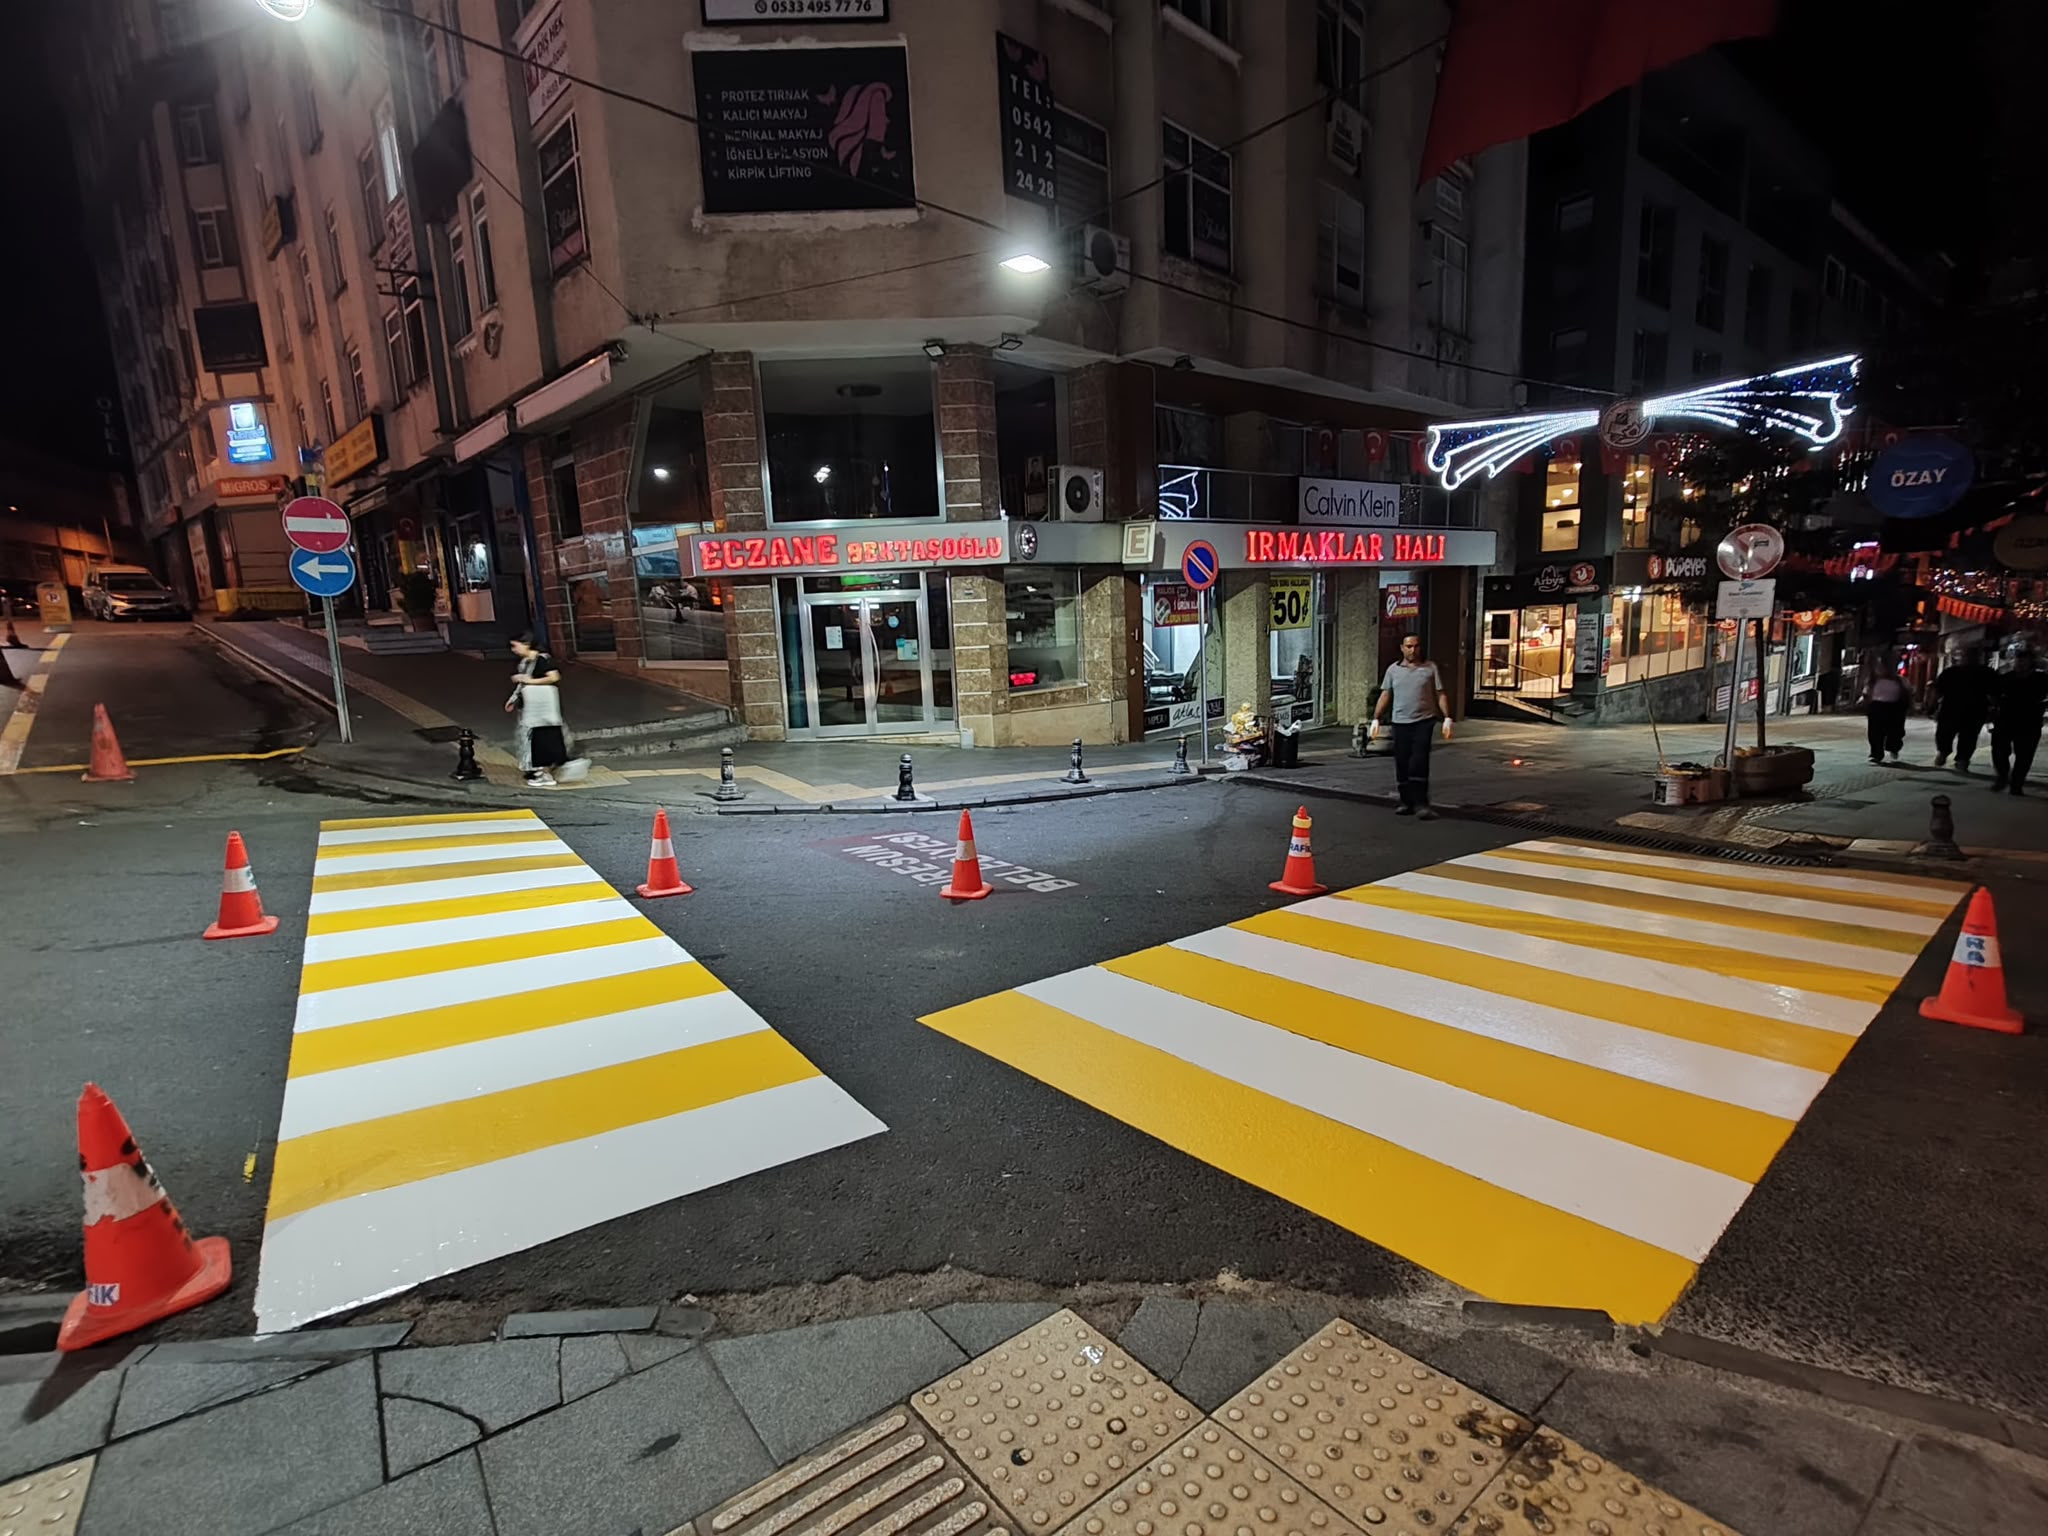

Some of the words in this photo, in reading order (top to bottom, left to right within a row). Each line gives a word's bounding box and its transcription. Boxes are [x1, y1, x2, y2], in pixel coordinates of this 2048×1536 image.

[771, 0, 804, 13] 0533
[807, 0, 831, 13] 495
[836, 0, 851, 12] 77
[856, 0, 872, 12] 76
[721, 90, 765, 102] PROTEZ
[767, 89, 810, 102] TIRNAK
[1010, 73, 1051, 109] TEL:
[723, 109, 760, 121] KALICI
[762, 108, 808, 121] MAKYAJ
[1012, 105, 1052, 140] 0542
[777, 128, 823, 141] MAKYAJ
[727, 166, 766, 180] KİRPİK
[768, 165, 812, 179] LİFTİNG
[1016, 170, 1034, 191] 24
[1037, 177, 1055, 199] 28
[1890, 466, 1947, 488] ÖZAY
[1303, 487, 1356, 517] Calvin
[1359, 489, 1395, 518] Klein
[699, 534, 839, 570] ECZANE
[1130, 529, 1145, 553] E
[1246, 530, 1384, 562] IRMAKLAR
[1393, 534, 1446, 561] HALI
[841, 844, 955, 888] İRESUN
